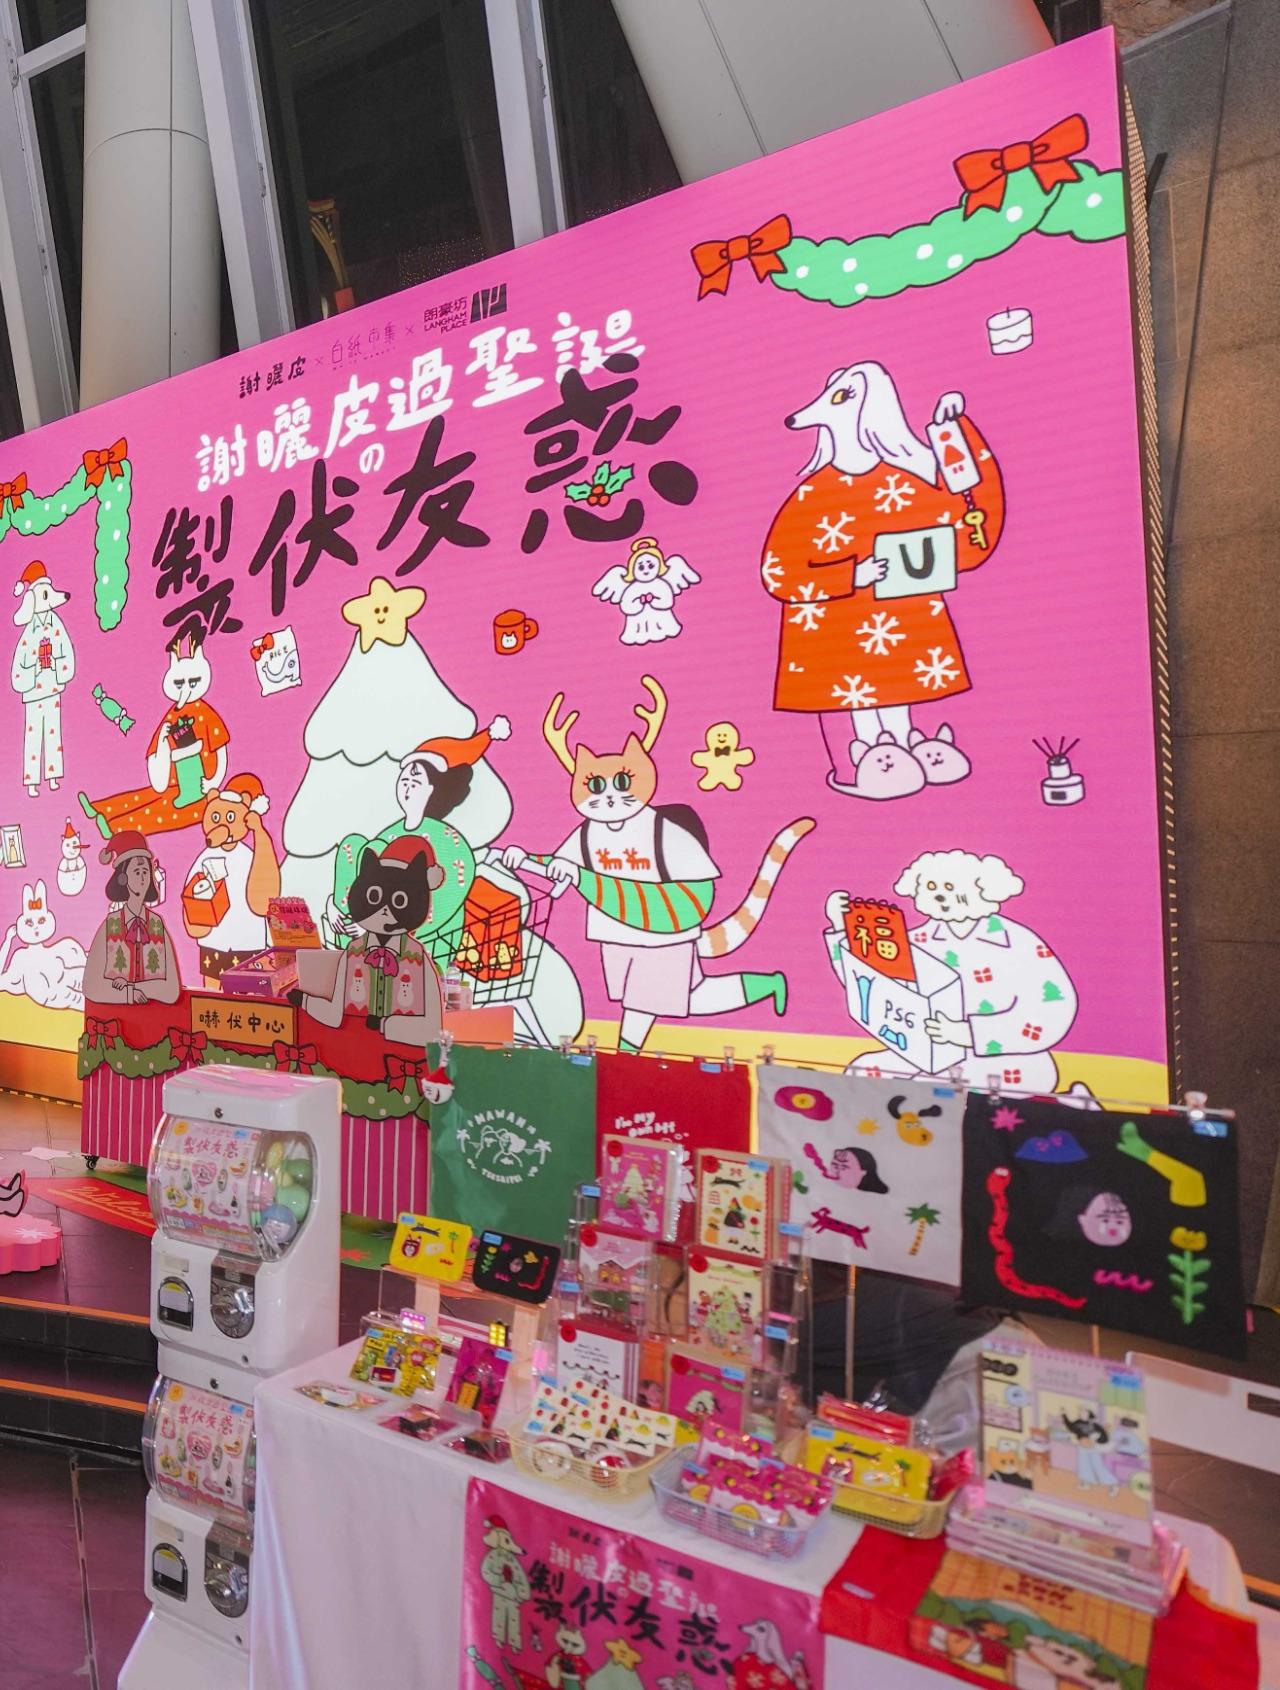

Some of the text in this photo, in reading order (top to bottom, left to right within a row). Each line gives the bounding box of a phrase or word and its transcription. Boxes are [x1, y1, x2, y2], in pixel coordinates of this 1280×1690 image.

[424, 296, 468, 322] 朗豪坊
[424, 312, 468, 331] LANGHAM
[440, 319, 468, 334] PLACE
[196, 310, 646, 492] 謝曬皮過聖誕
[360, 443, 385, 474] の
[152, 353, 699, 650] 製伏友惑
[900, 537, 935, 580] U
[853, 914, 899, 962] 福
[199, 1010, 285, 1034] 嚇伏中心
